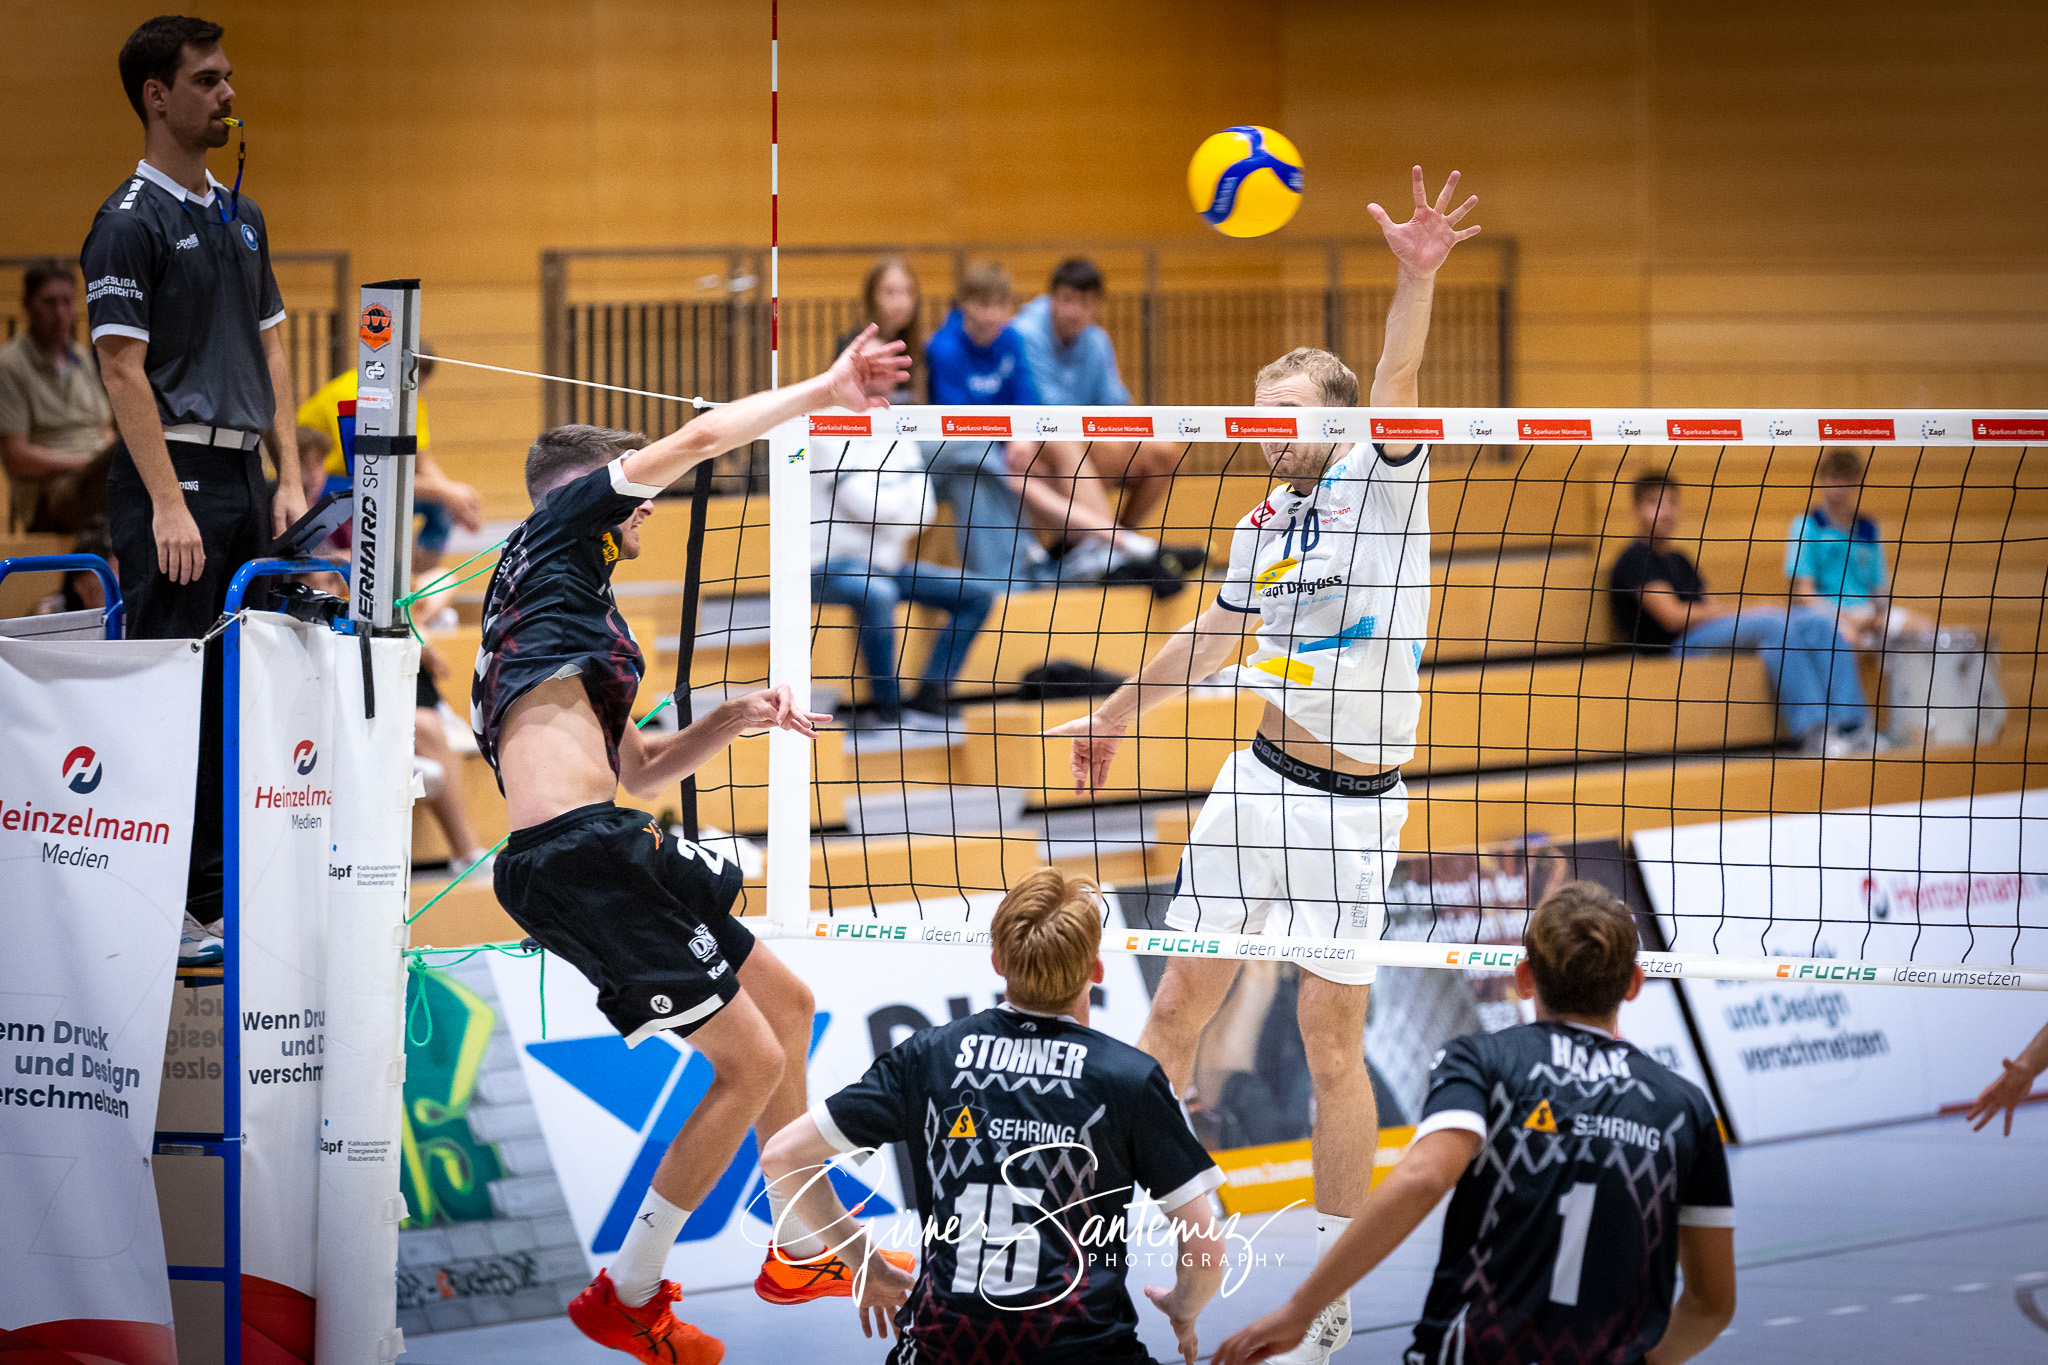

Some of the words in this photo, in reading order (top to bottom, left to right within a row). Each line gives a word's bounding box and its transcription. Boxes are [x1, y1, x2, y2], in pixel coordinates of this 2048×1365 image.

[88, 275, 137, 291] BUNESLIGA
[901, 425, 918, 433] Zapf
[956, 424, 981, 432] Sparkasse
[1042, 425, 1058, 433] Zapf
[1097, 425, 1123, 433] Sparkasse
[1184, 426, 1200, 434] Zapf
[1240, 426, 1267, 434] Sparkasse
[1329, 427, 1345, 435] Zapf
[1386, 427, 1412, 435] Sparkasse
[1476, 428, 1492, 436] Zapf
[1533, 427, 1560, 435] Sparkasse
[1561, 428, 1587, 436] Nürnberg
[1624, 428, 1641, 437] Zapf
[1712, 428, 1737, 436] Nürnberg
[1864, 428, 1890, 436] Nürnberg
[1988, 428, 2017, 436] Sparkasse
[2018, 428, 2045, 436] Nürnberg
[362, 423, 380, 489] SPOT
[1263, 585, 1283, 598] apf
[1255, 737, 1320, 782] oadbox
[1336, 772, 1398, 790] Roadb
[0, 801, 170, 845] einzelmann
[292, 813, 322, 830] Medien
[42, 842, 109, 870] Medien
[836, 924, 907, 939] FUCHS
[921, 927, 961, 942] Ideen
[1147, 938, 1221, 953] FUCHS
[1235, 940, 1276, 956] Ideen
[1281, 944, 1356, 960] umsetzen
[1468, 952, 1528, 966] FUCH
[1800, 965, 1877, 980] FUCHS
[1893, 967, 1937, 983] Ideen
[1942, 970, 2021, 986] umsetzen
[243, 1011, 300, 1031] Wenn
[304, 1008, 325, 1029] Dru
[53, 1020, 109, 1052] Druck
[281, 1034, 315, 1057] und
[955, 1034, 1088, 1080] STOHNER
[15, 1053, 74, 1077] und
[82, 1054, 140, 1094] Design
[249, 1062, 323, 1085] verschm
[988, 1118, 1076, 1144] SEHRING
[951, 1182, 1044, 1296] 15
[1549, 1182, 1598, 1307] 1
